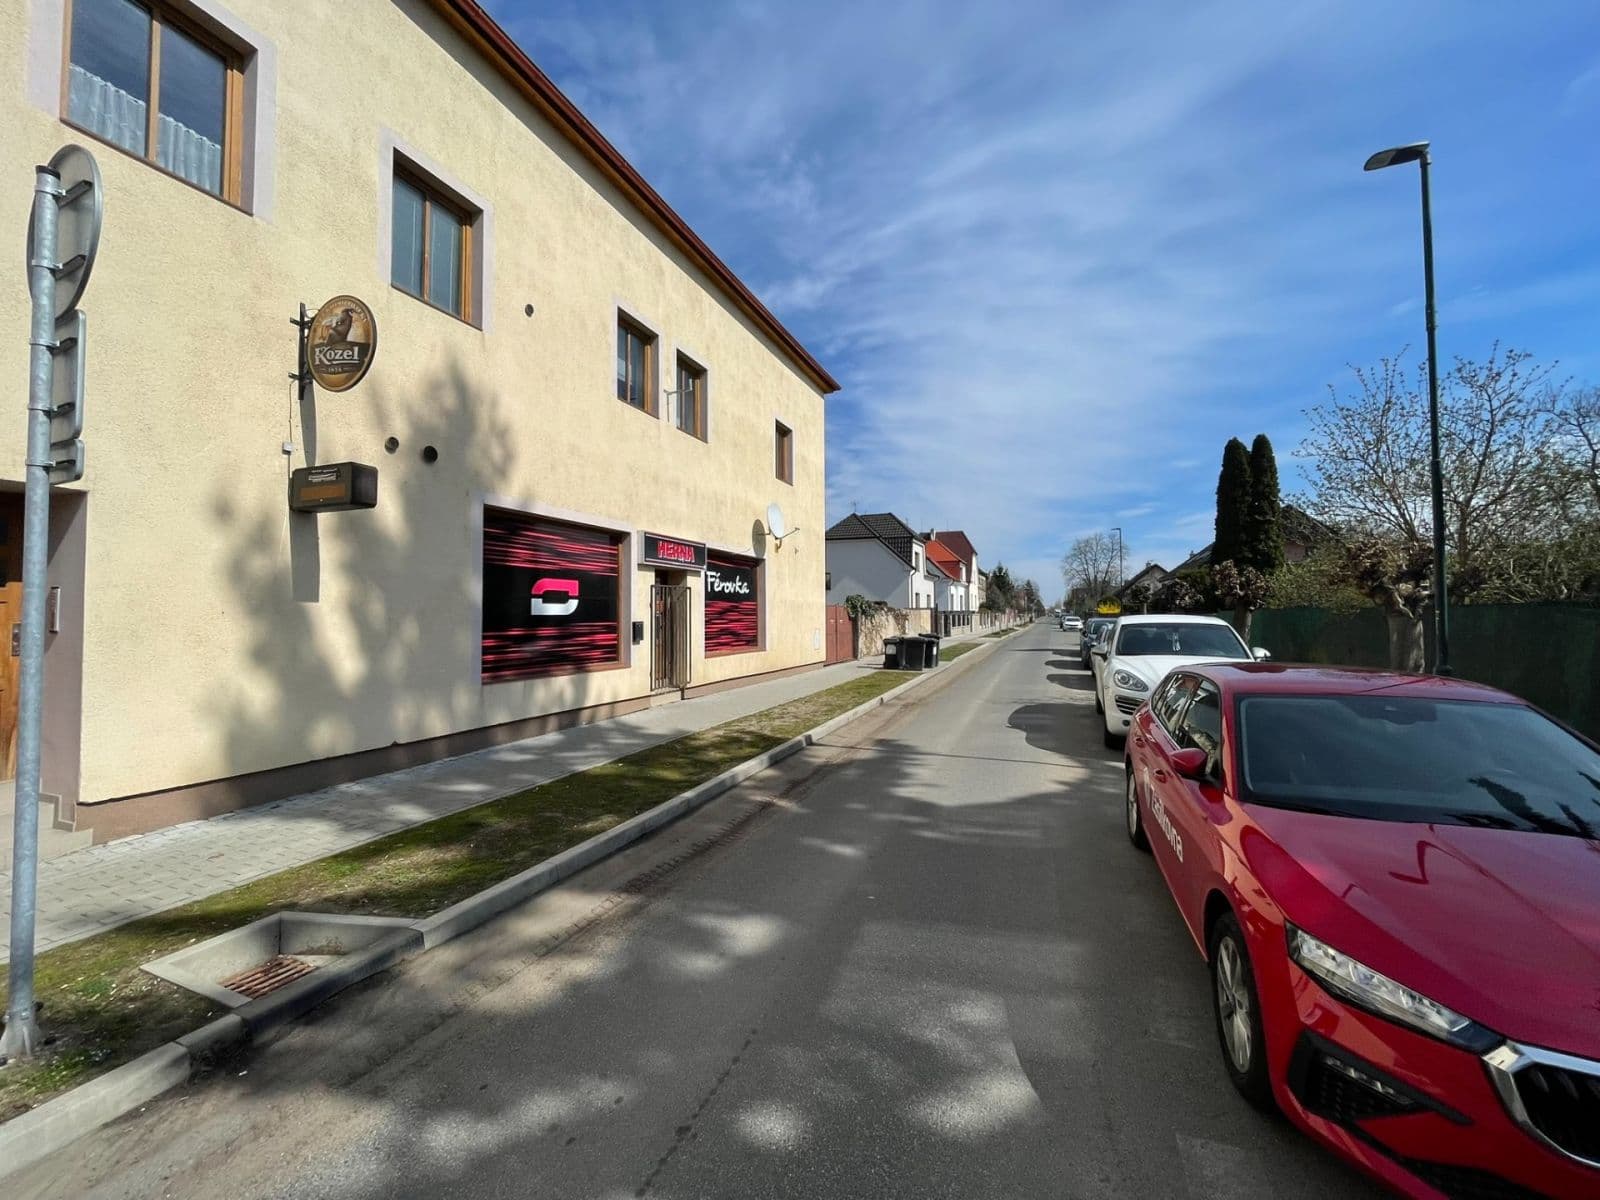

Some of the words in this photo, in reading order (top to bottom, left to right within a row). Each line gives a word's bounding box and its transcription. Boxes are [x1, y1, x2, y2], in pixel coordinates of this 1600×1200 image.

[314, 346, 360, 365] Kozel
[656, 541, 695, 563] HERNA
[705, 571, 750, 594] Férovka
